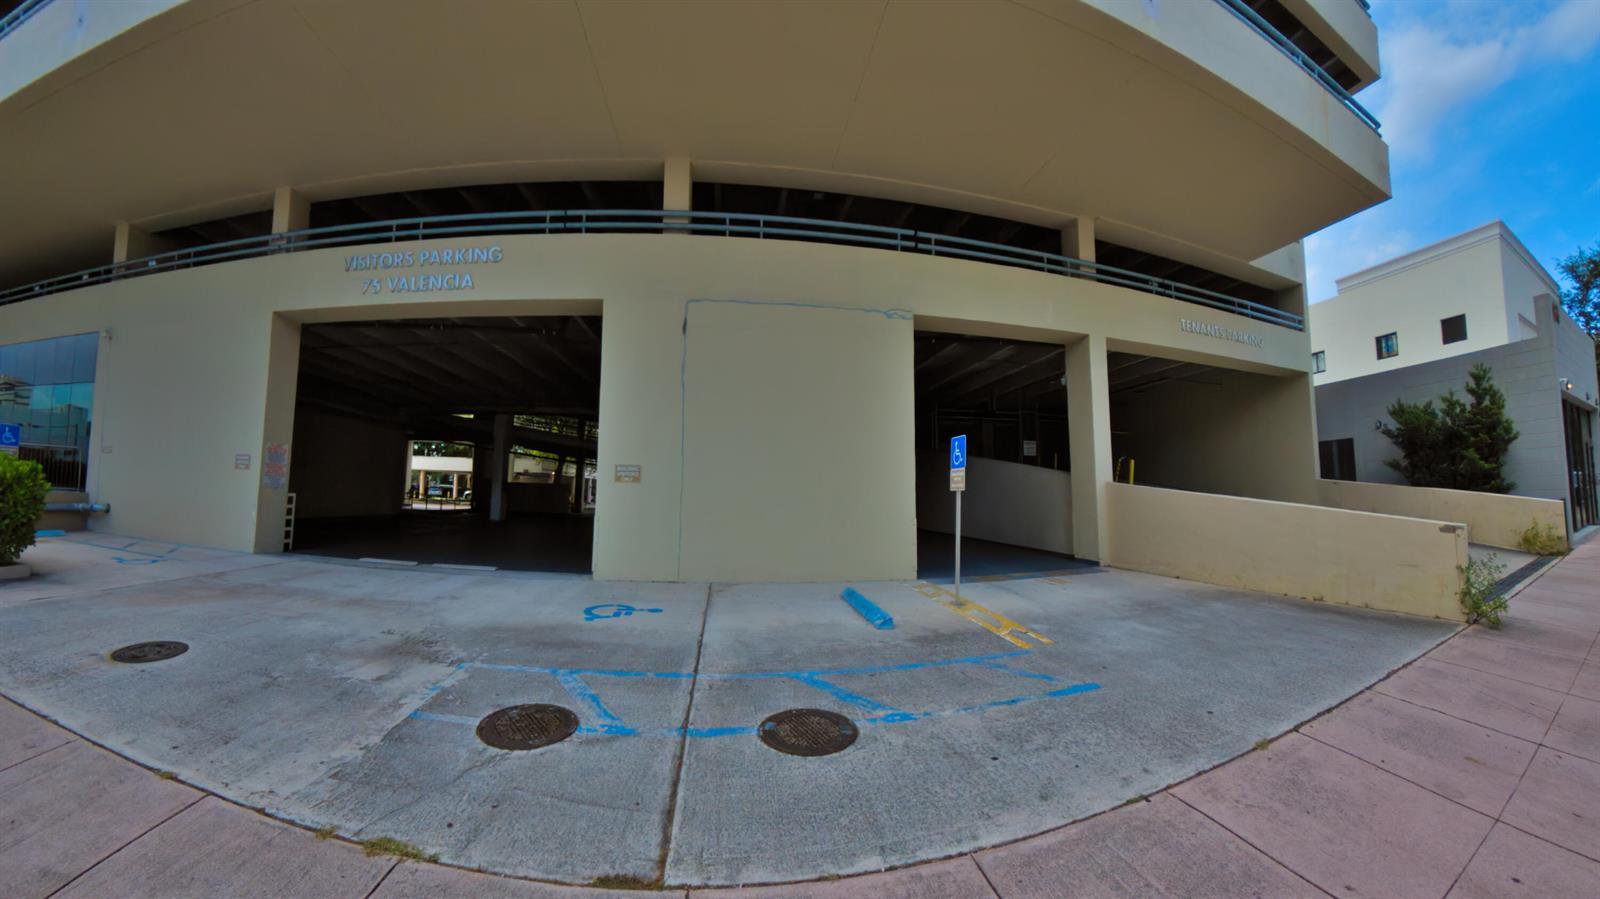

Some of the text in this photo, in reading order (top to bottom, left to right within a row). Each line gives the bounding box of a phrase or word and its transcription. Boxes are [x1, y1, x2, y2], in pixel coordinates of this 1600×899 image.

[344, 246, 503, 272] VISITORS PARKING
[362, 272, 474, 294] 75 VALENCIA
[1181, 319, 1225, 338] TENANTS
